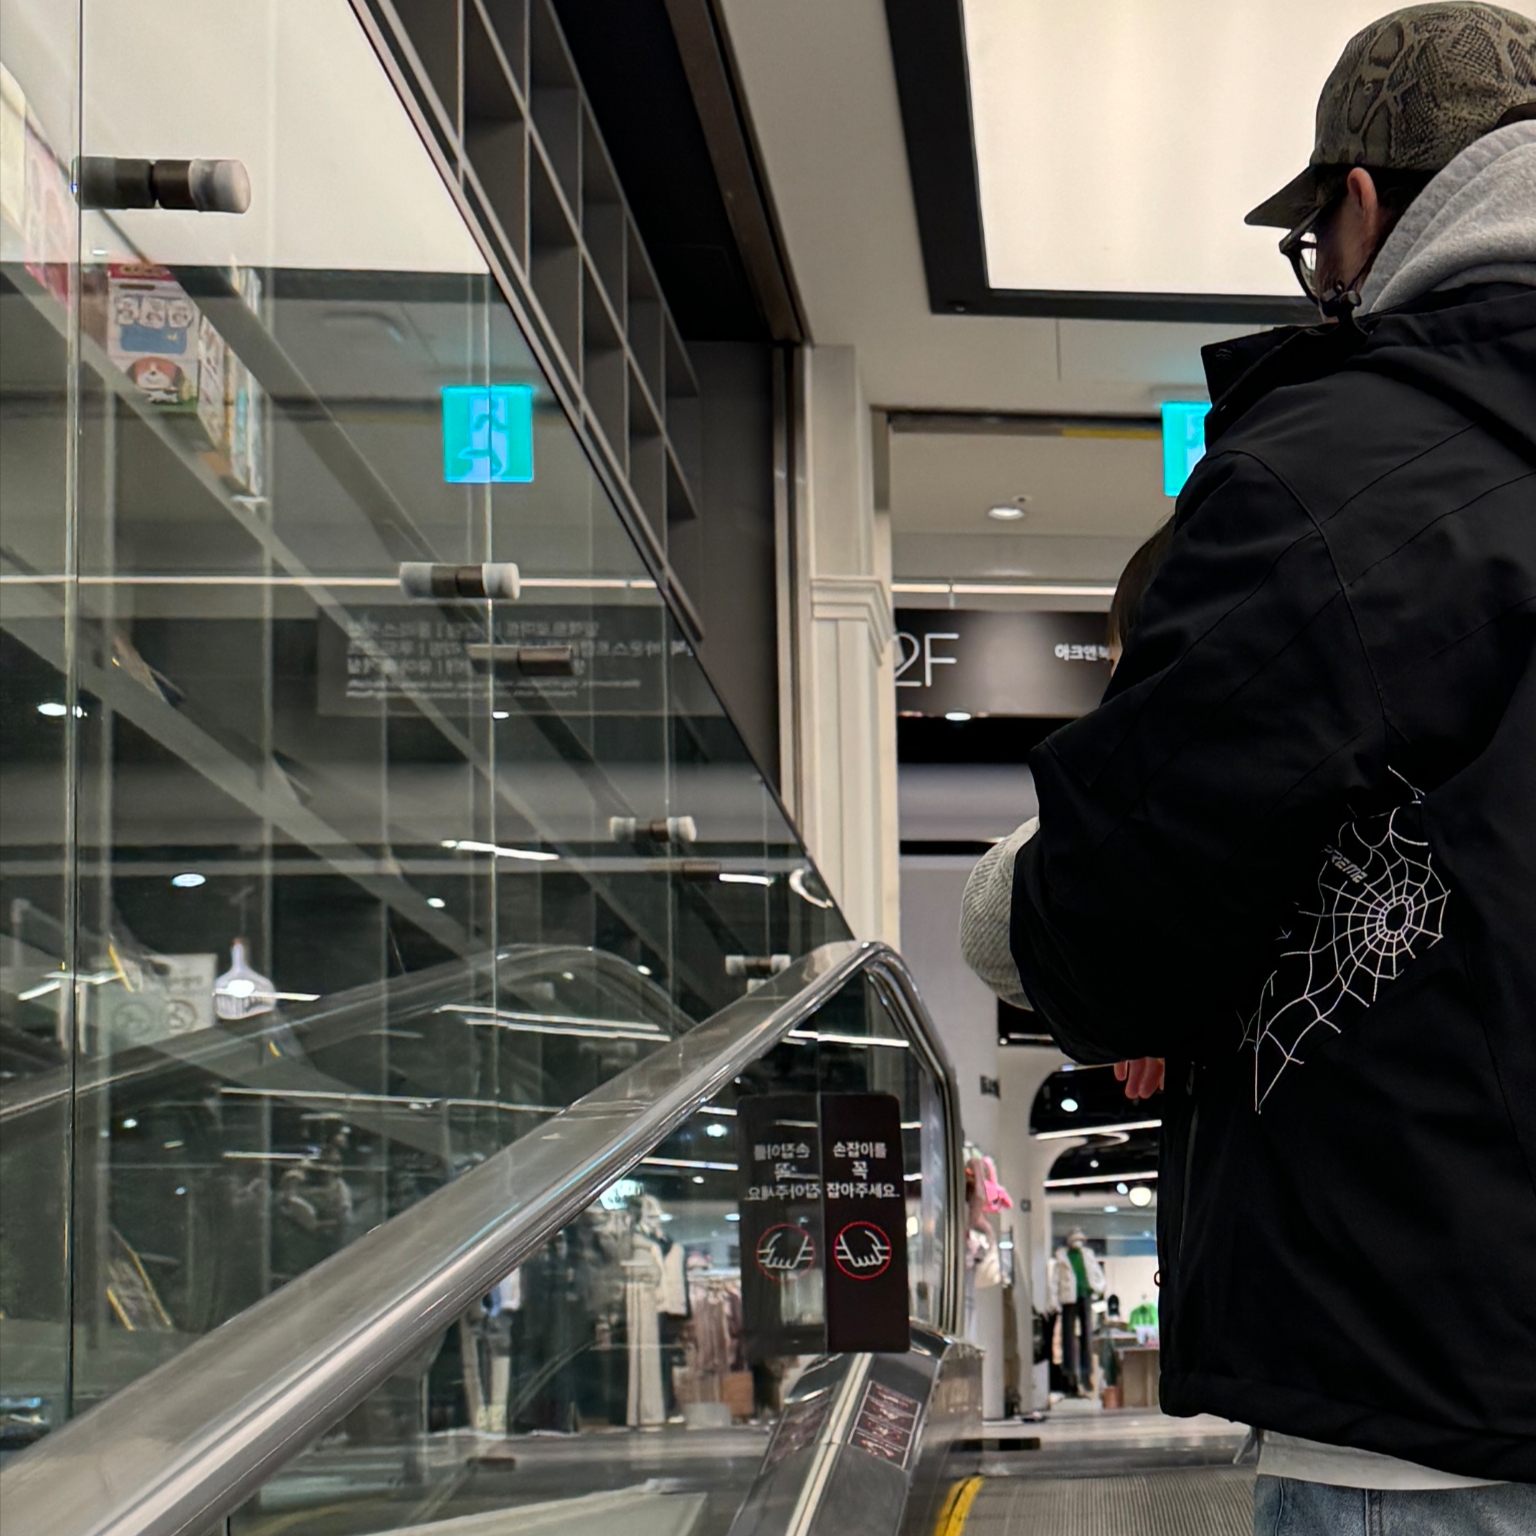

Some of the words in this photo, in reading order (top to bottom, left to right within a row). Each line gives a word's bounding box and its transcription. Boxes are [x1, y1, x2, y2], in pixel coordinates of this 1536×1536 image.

[894, 632, 959, 687] 2F
[833, 1141, 887, 1159] 손잡이를
[852, 1161, 868, 1180] 꼭
[827, 1182, 900, 1199] 잡아주세요.
